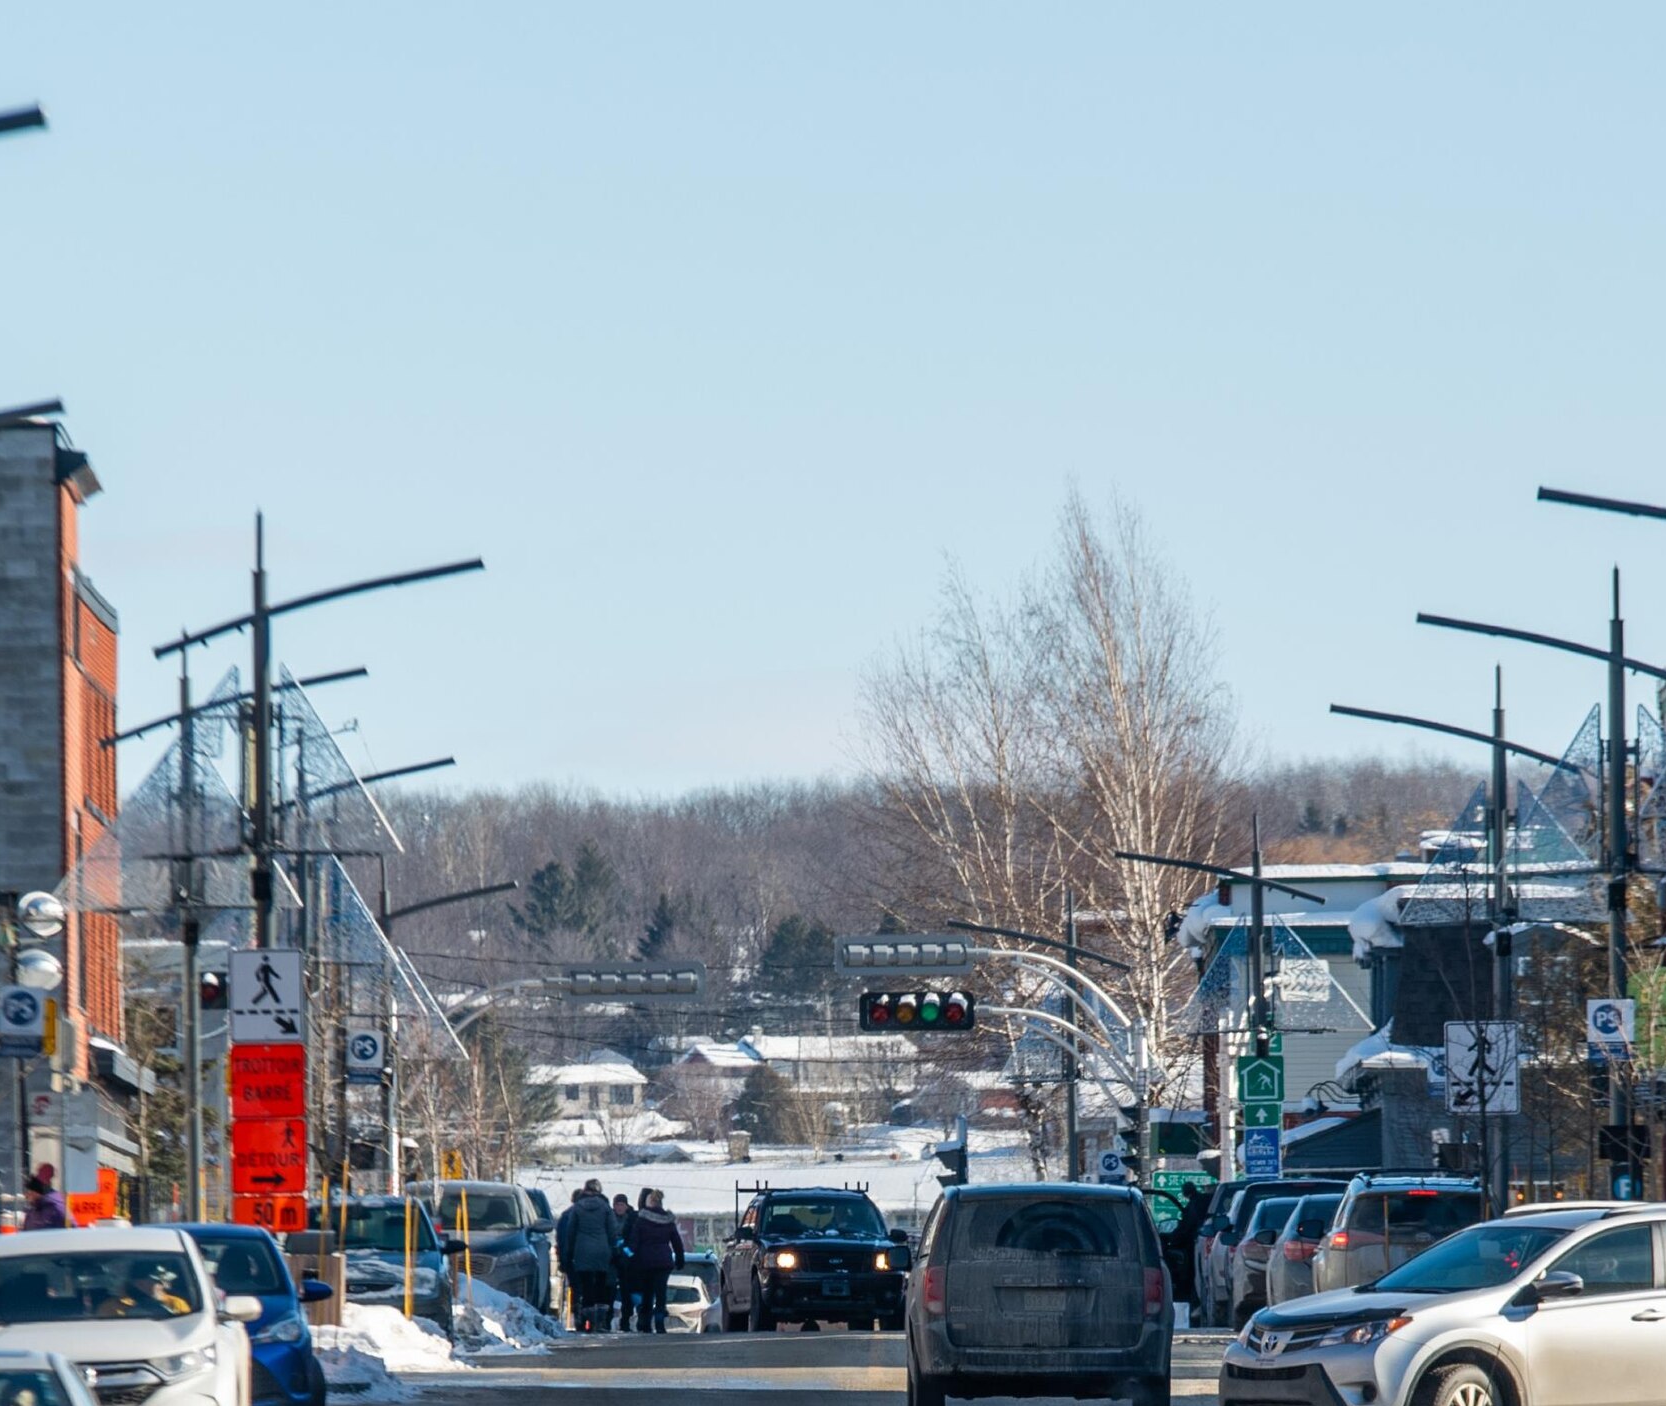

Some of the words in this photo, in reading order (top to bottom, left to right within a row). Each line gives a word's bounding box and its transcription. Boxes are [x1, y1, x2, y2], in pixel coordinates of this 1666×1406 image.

[233, 1058, 301, 1073] TROTTOIR
[243, 1081, 292, 1101] BARRÉ
[253, 1202, 275, 1225] 50
